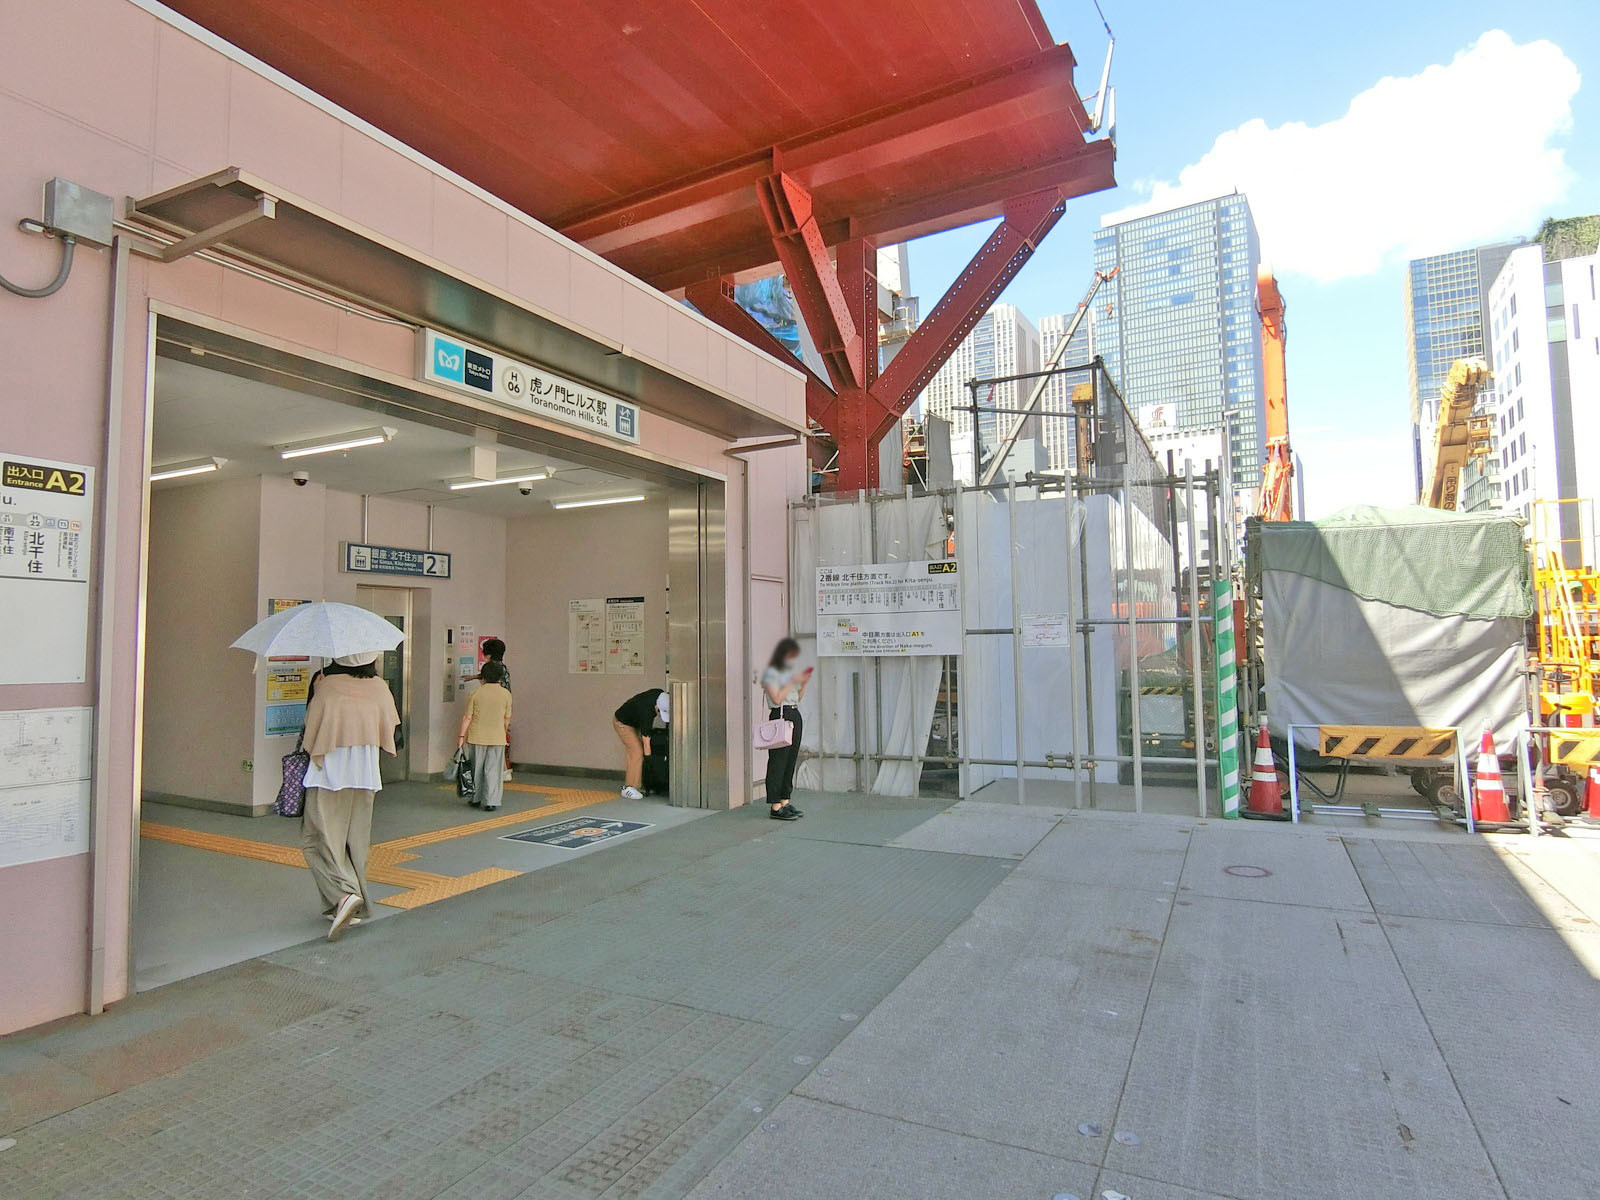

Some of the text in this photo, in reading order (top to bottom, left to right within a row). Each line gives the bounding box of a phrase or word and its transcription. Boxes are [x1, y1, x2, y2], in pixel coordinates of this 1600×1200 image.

[511, 371, 518, 382] H
[507, 381, 520, 394] 06
[529, 377, 607, 417] 虎ノ門ヒルズ駅
[529, 393, 610, 428] Toranomon Hills Sta.
[7, 465, 44, 480] 出入口
[7, 477, 44, 488] Entrance
[45, 470, 85, 494] A2
[3, 526, 15, 554] 南千住
[28, 531, 45, 573] 北千住
[426, 555, 437, 575] 2
[942, 562, 958, 573] A2
[819, 573, 840, 582] 2番線
